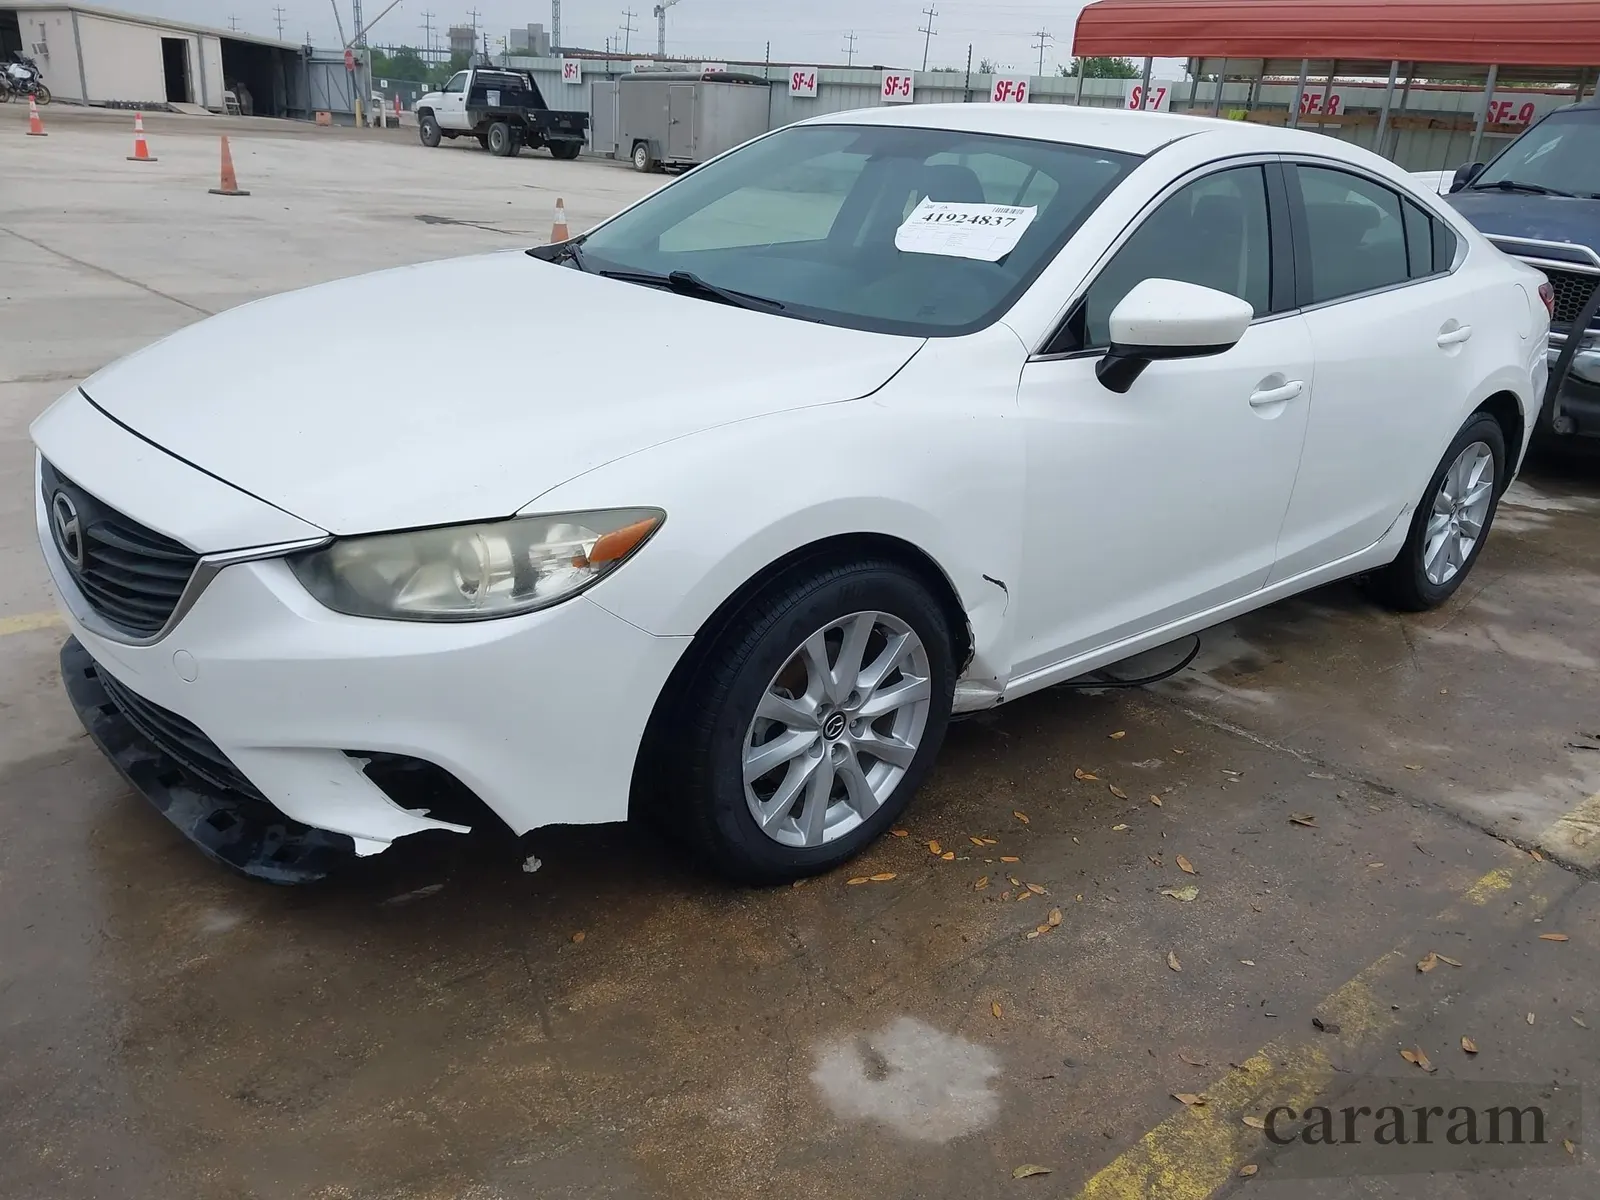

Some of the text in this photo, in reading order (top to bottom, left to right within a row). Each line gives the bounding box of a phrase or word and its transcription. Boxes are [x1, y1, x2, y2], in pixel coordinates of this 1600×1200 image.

[564, 63, 579, 79] SF-1
[792, 72, 815, 91] SF-4
[884, 76, 910, 96] SF-5
[995, 81, 1026, 103] SF-6
[922, 212, 1017, 228] 41924837
